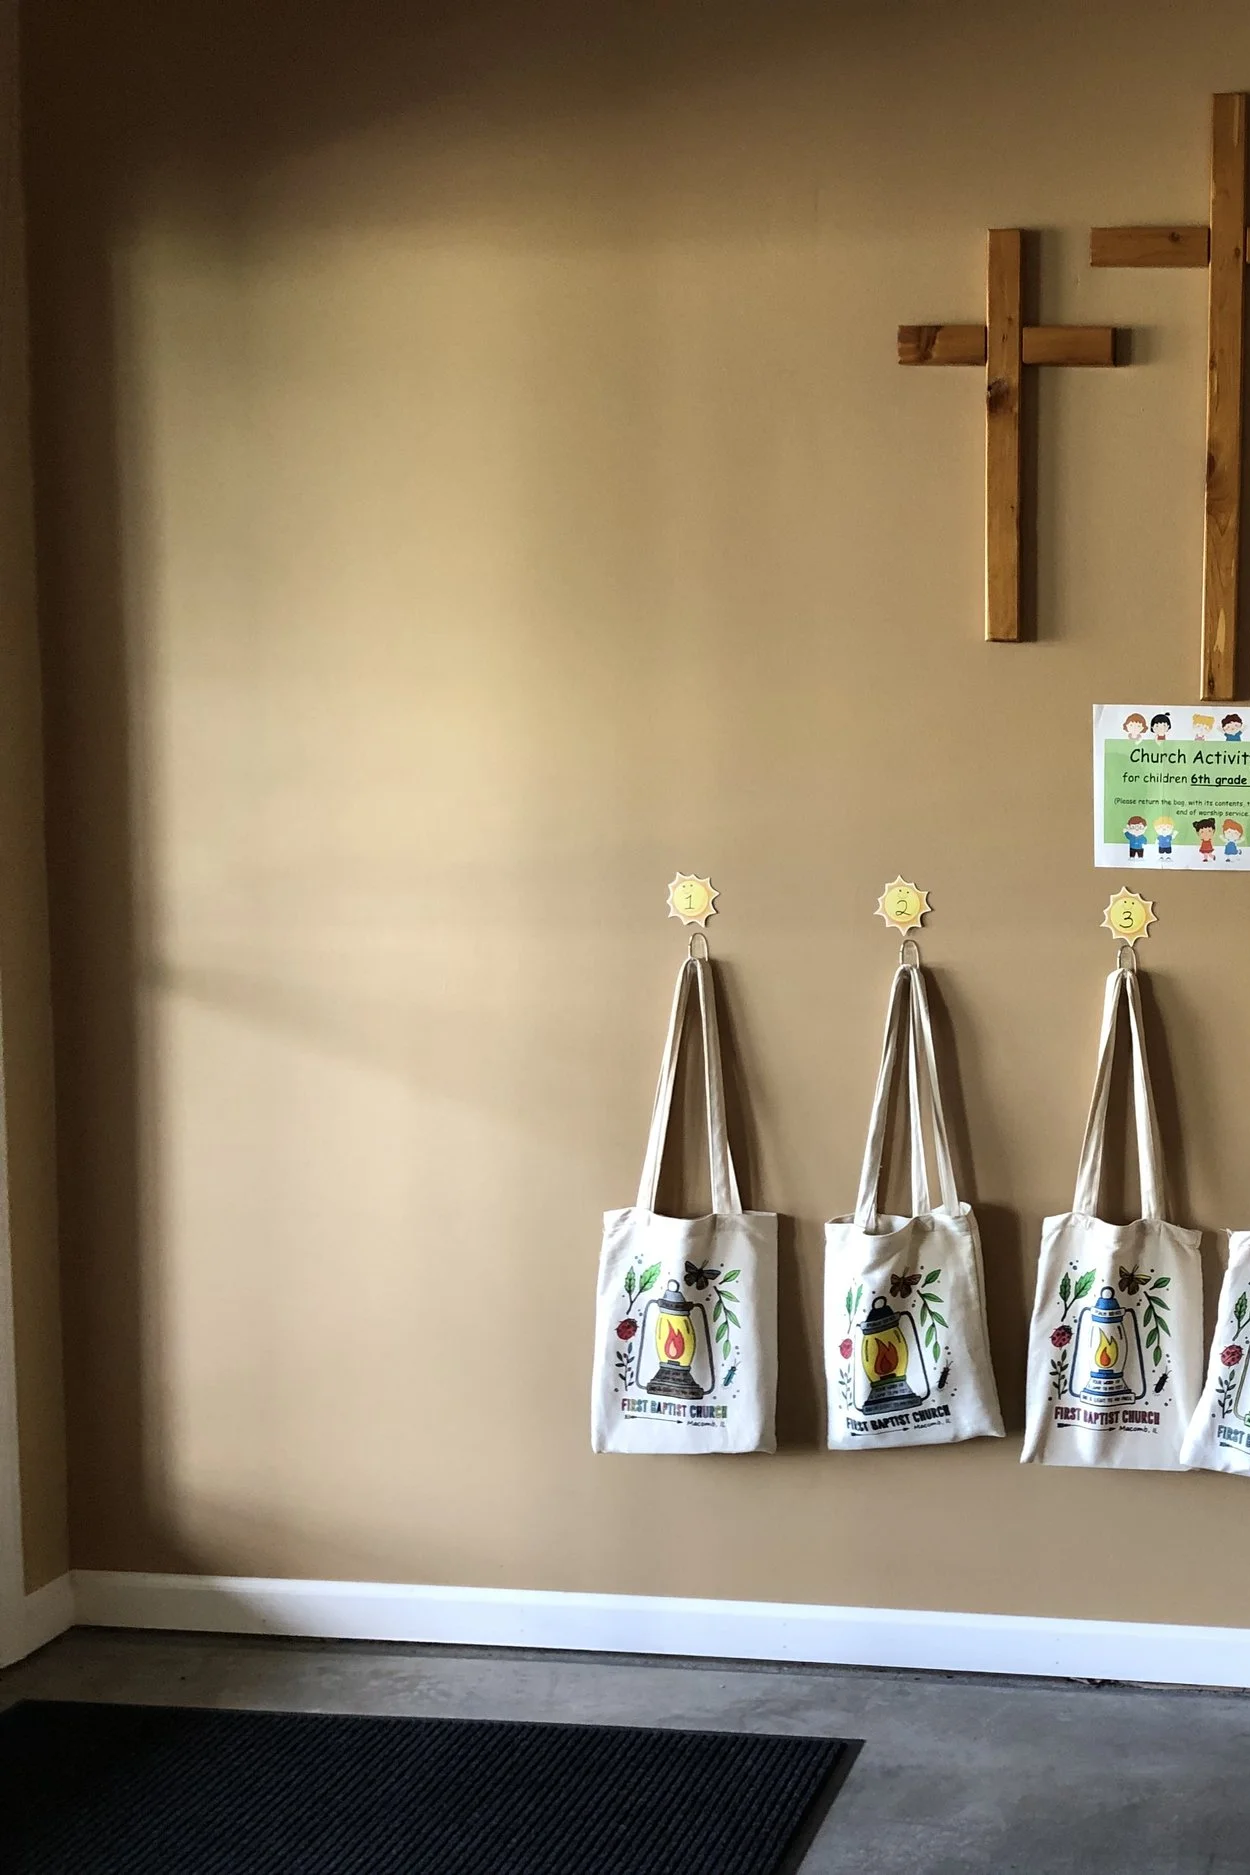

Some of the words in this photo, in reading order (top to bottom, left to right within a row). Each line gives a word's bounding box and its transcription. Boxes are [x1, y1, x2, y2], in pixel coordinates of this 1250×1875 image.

[1130, 749, 1186, 764] Church
[1123, 772, 1140, 783] for
[1143, 773, 1188, 783] children
[1190, 775, 1211, 785] 6th
[1215, 776, 1247, 787] grade
[1198, 810, 1224, 818] worship
[684, 895, 695, 909] 1
[895, 900, 911, 916] 2
[1119, 911, 1134, 928] 3
[621, 1399, 648, 1413] FIRST
[650, 1402, 686, 1417] BAPTIST
[690, 1405, 727, 1418] CHURCH
[1055, 1407, 1080, 1420] FIRST
[1084, 1410, 1120, 1425] BAPTIST
[1122, 1410, 1160, 1425] CHURCH
[846, 1417, 869, 1431] FIRST
[871, 1414, 910, 1431] BAPTIST
[914, 1404, 951, 1422] CHURCH
[1217, 1425, 1244, 1444] FIRST
